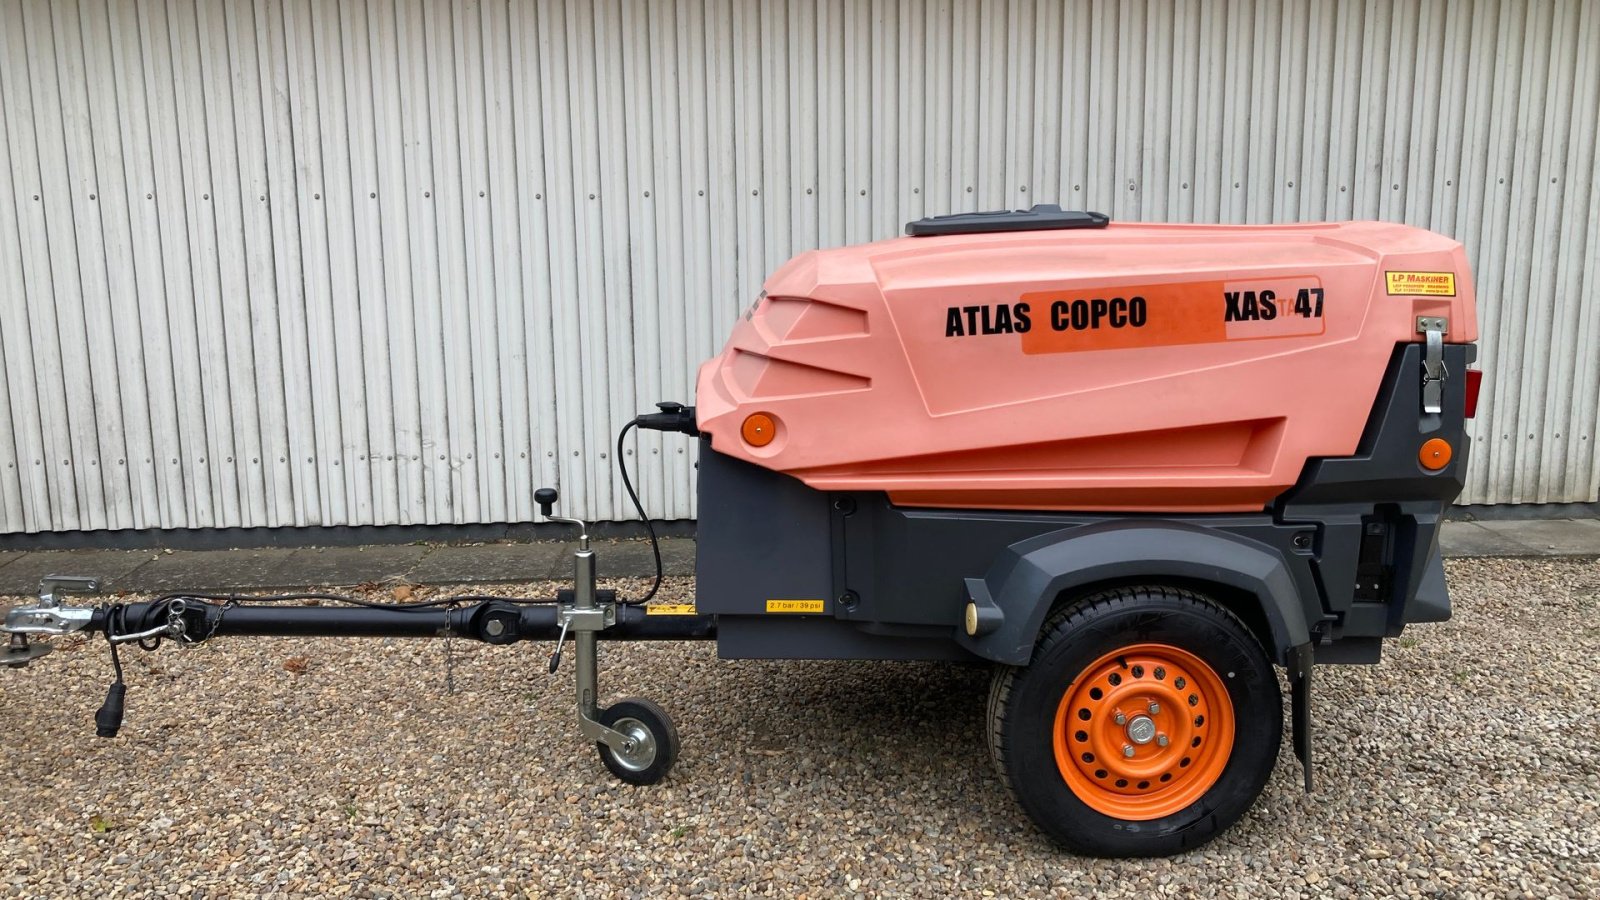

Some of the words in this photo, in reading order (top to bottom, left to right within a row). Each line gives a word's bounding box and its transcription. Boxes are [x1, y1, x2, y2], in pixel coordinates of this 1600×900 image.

[1392, 274, 1405, 282] LP
[946, 303, 1031, 337] ATLAS
[1051, 297, 1147, 331] COPCO
[1224, 290, 1277, 322] XAS
[1294, 288, 1324, 318] 47
